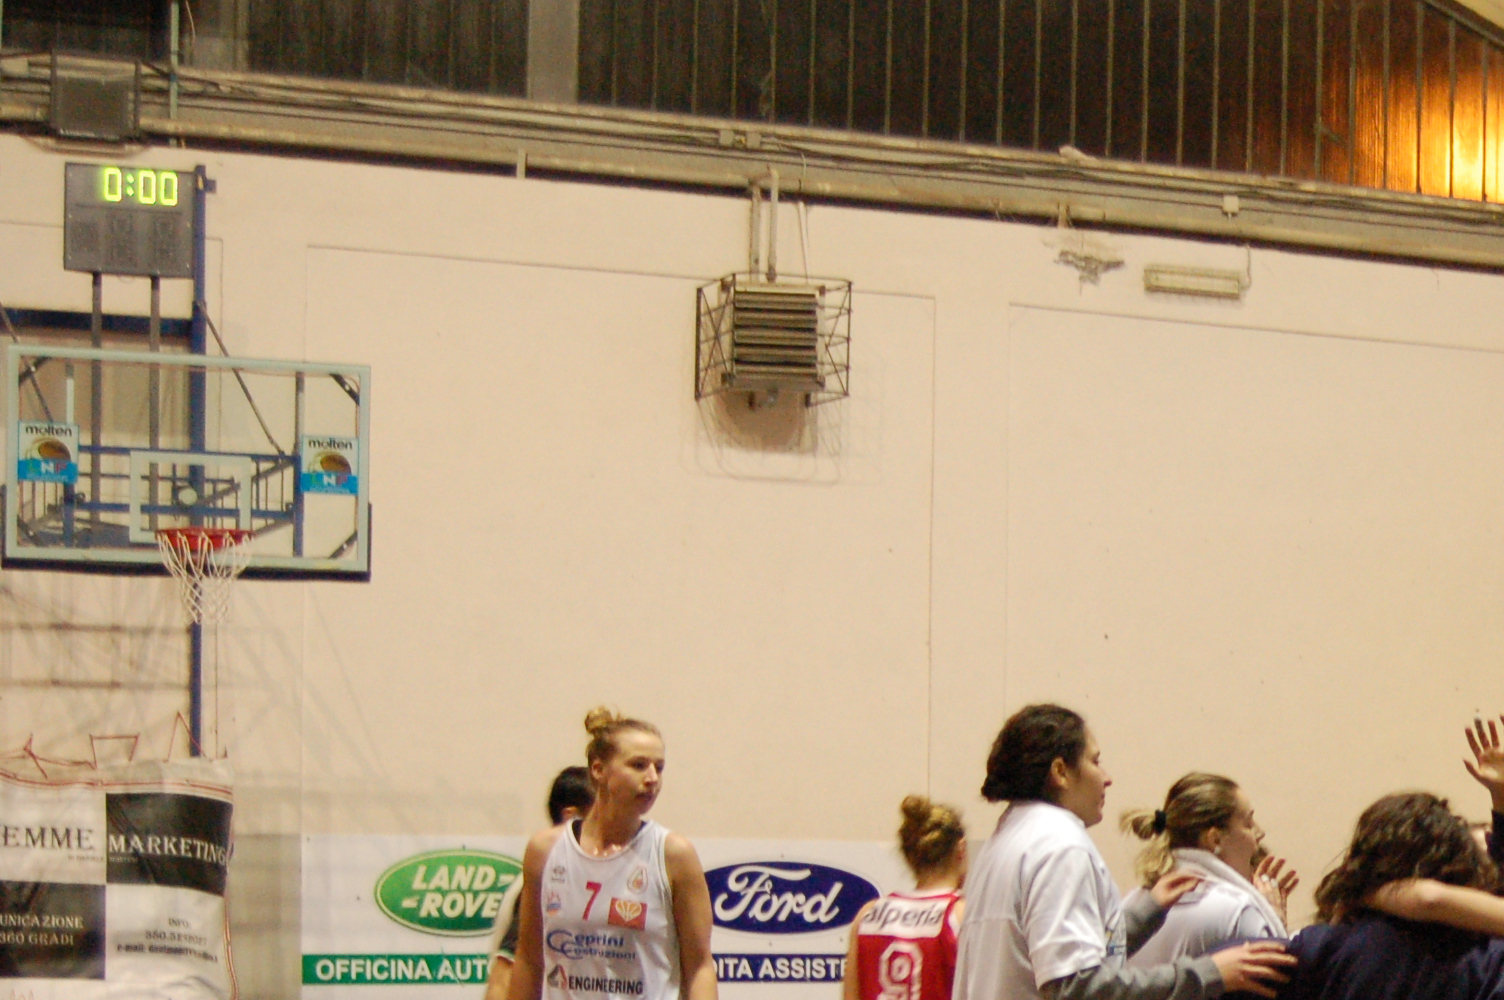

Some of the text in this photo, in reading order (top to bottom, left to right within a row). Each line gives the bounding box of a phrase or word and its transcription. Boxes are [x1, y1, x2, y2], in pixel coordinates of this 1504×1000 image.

[104, 167, 178, 206] 0:00
[25, 424, 72, 437] molten
[308, 437, 353, 450] molten
[108, 834, 227, 865] MARKETING
[412, 865, 496, 890] LAND
[419, 893, 502, 918] ROVE
[582, 881, 602, 920] 7
[714, 865, 843, 924] Ford
[28, 932, 75, 946] GRADI
[315, 958, 491, 981] OFFICINA AUT
[568, 975, 644, 995] ENGINEERING
